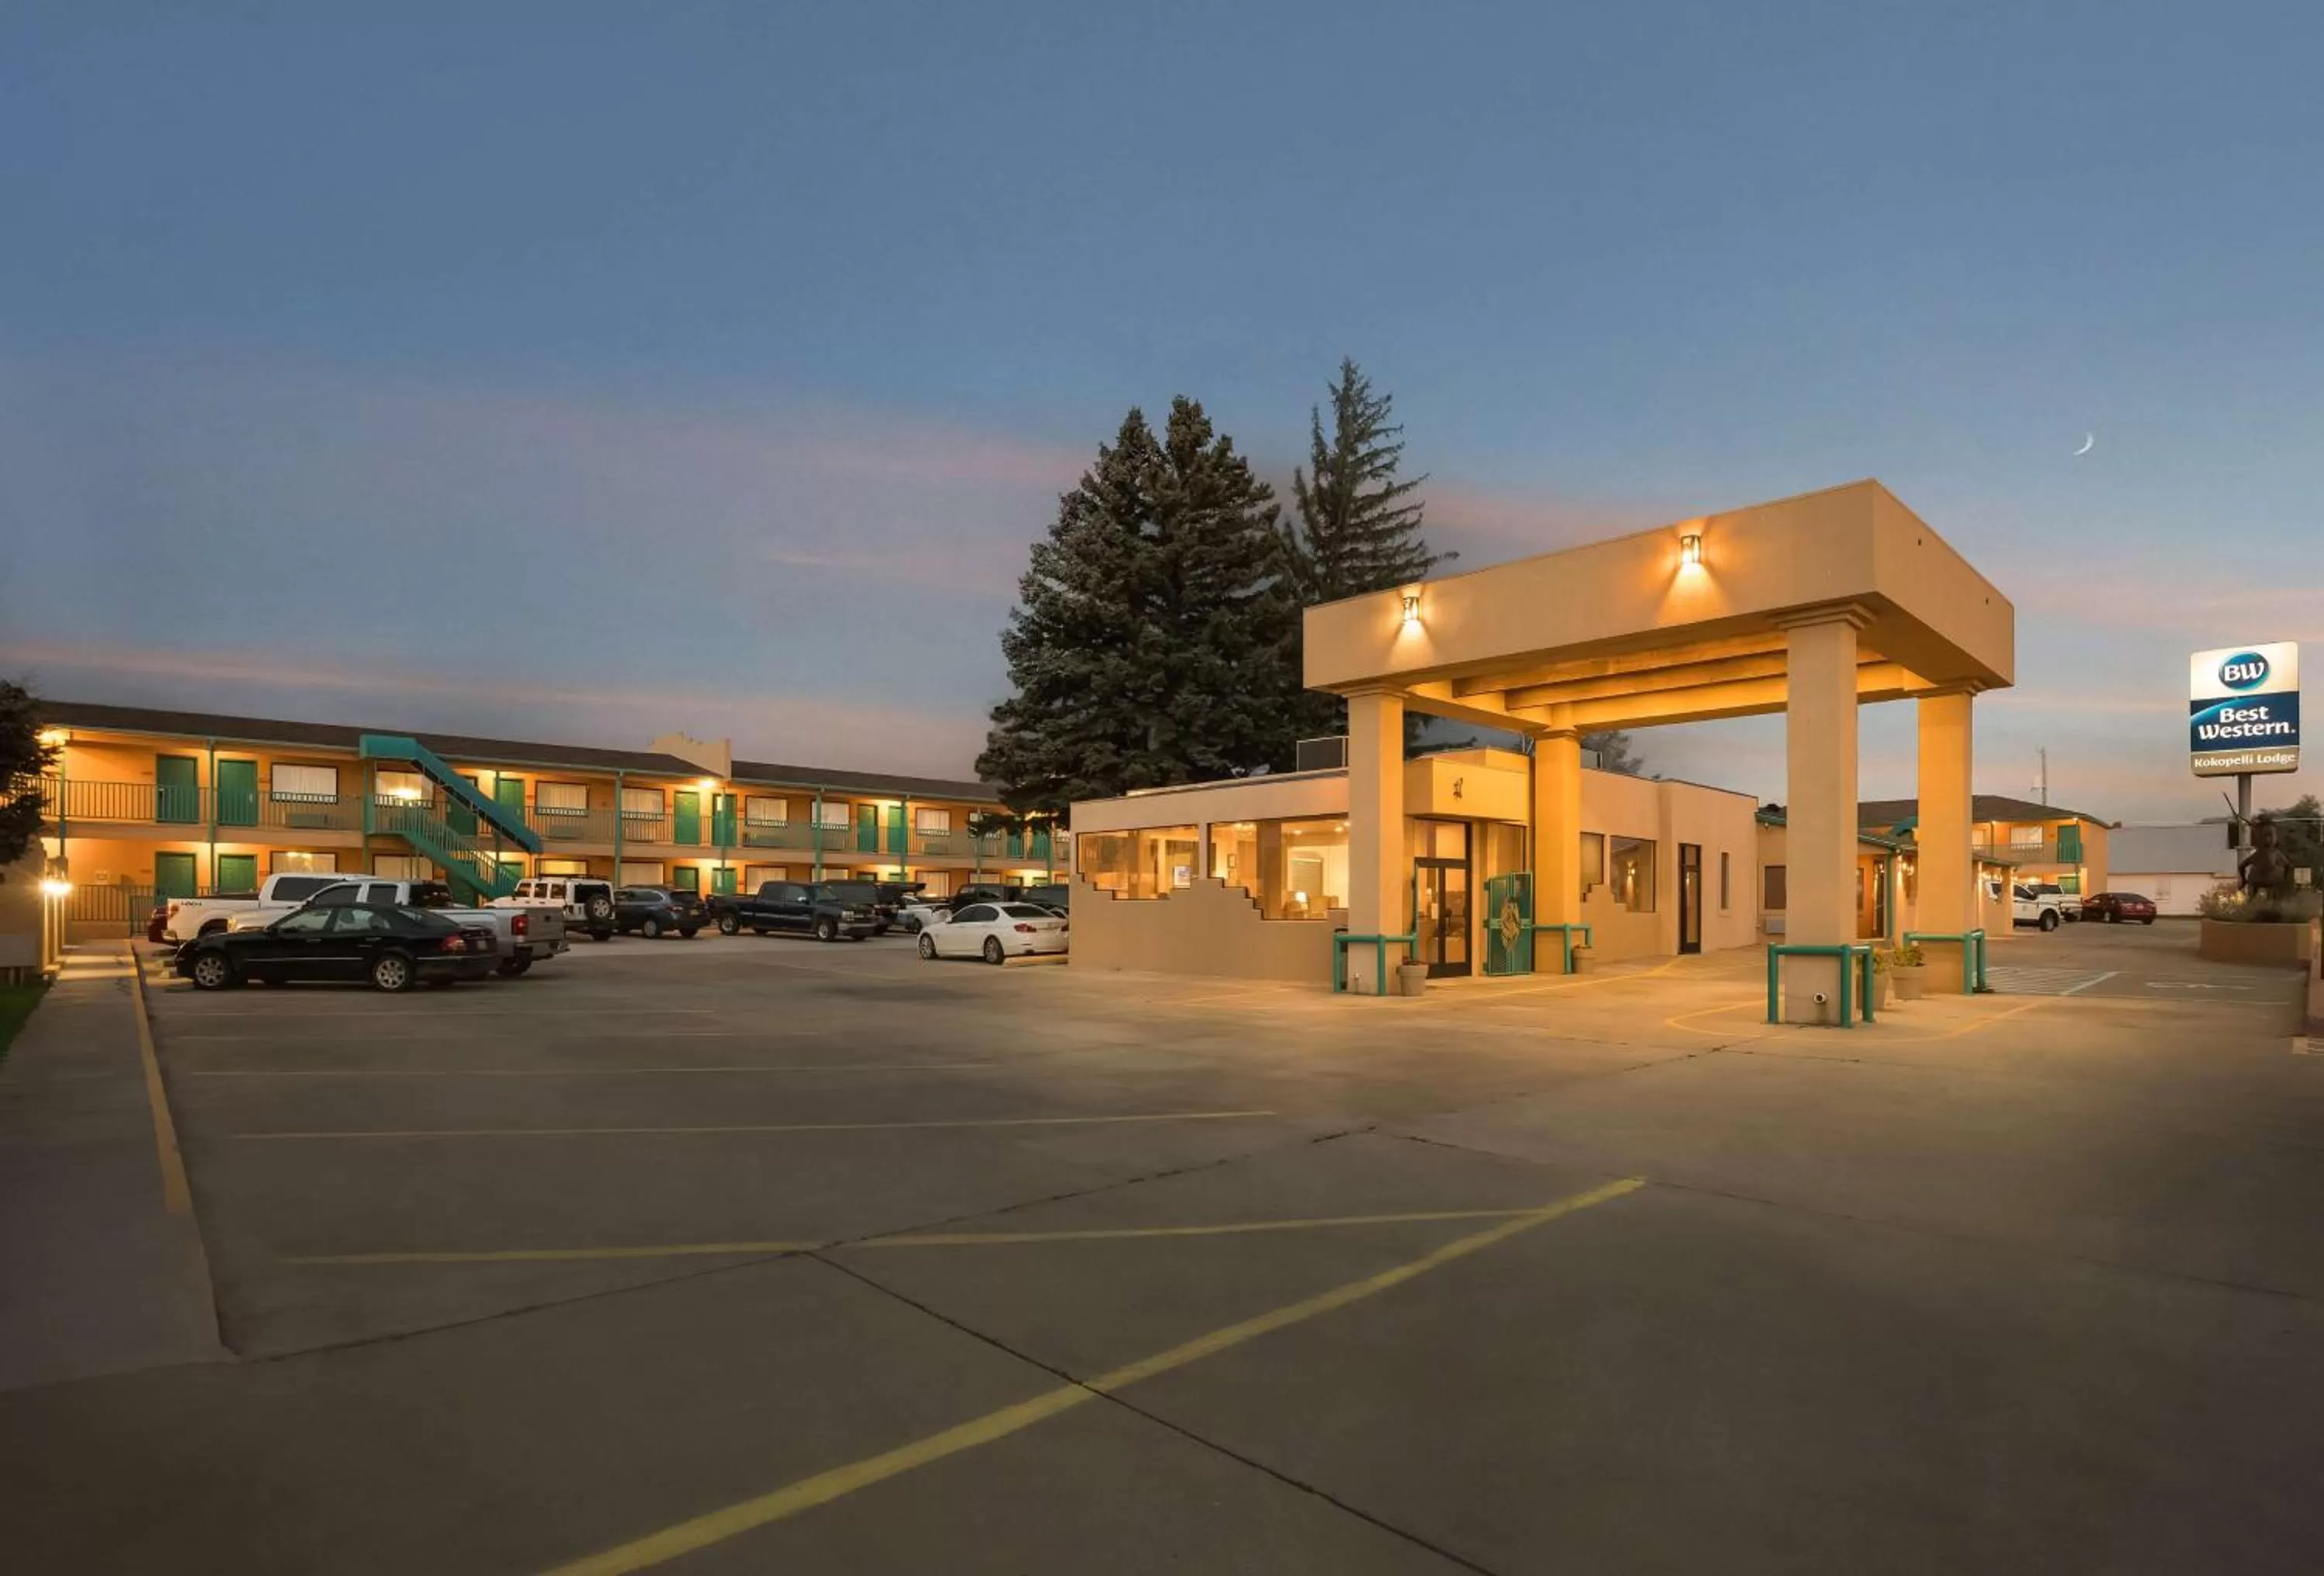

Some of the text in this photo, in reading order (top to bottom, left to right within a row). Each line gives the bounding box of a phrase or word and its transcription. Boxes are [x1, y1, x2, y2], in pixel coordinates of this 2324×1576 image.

[2224, 662, 2265, 682] BW
[2219, 706, 2269, 723] Best
[2195, 752, 2297, 768] Kokopelli Lodge
